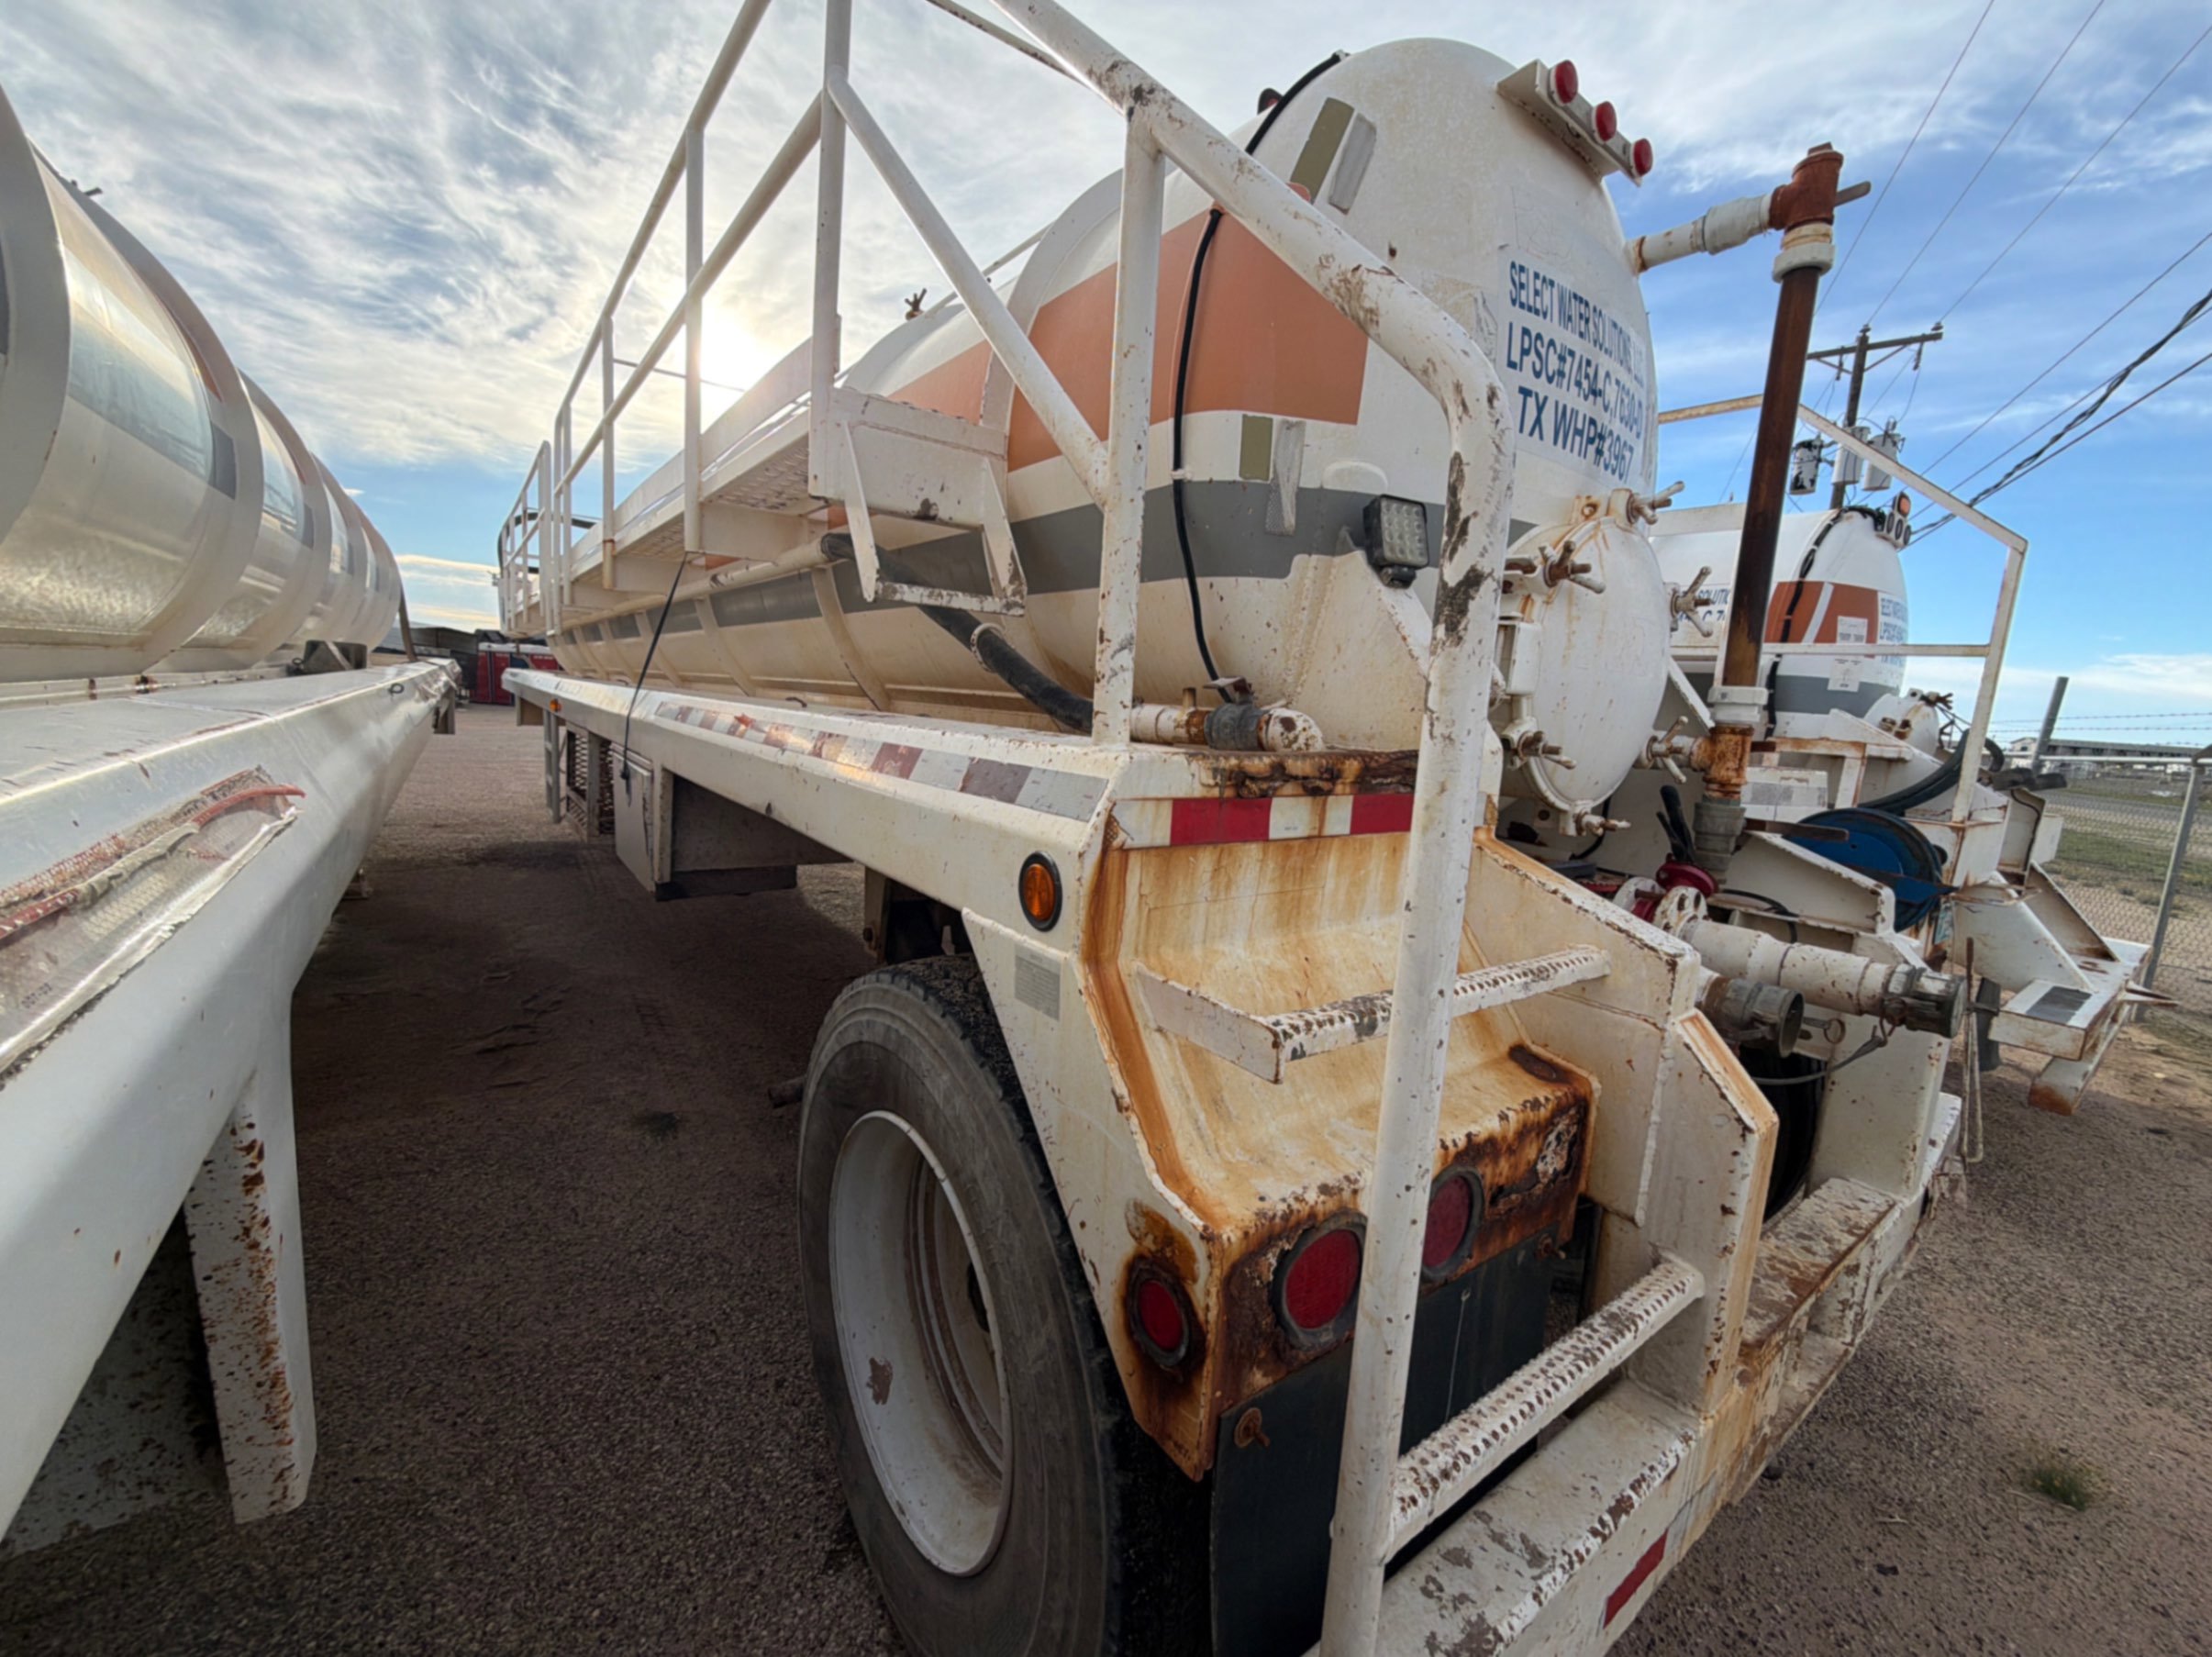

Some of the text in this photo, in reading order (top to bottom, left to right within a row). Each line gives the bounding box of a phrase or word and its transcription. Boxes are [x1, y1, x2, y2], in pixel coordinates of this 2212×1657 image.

[1509, 260, 1555, 323] SELECT
[1557, 282, 1592, 343] WATER
[1517, 385, 1634, 484] TX WHP#3967
